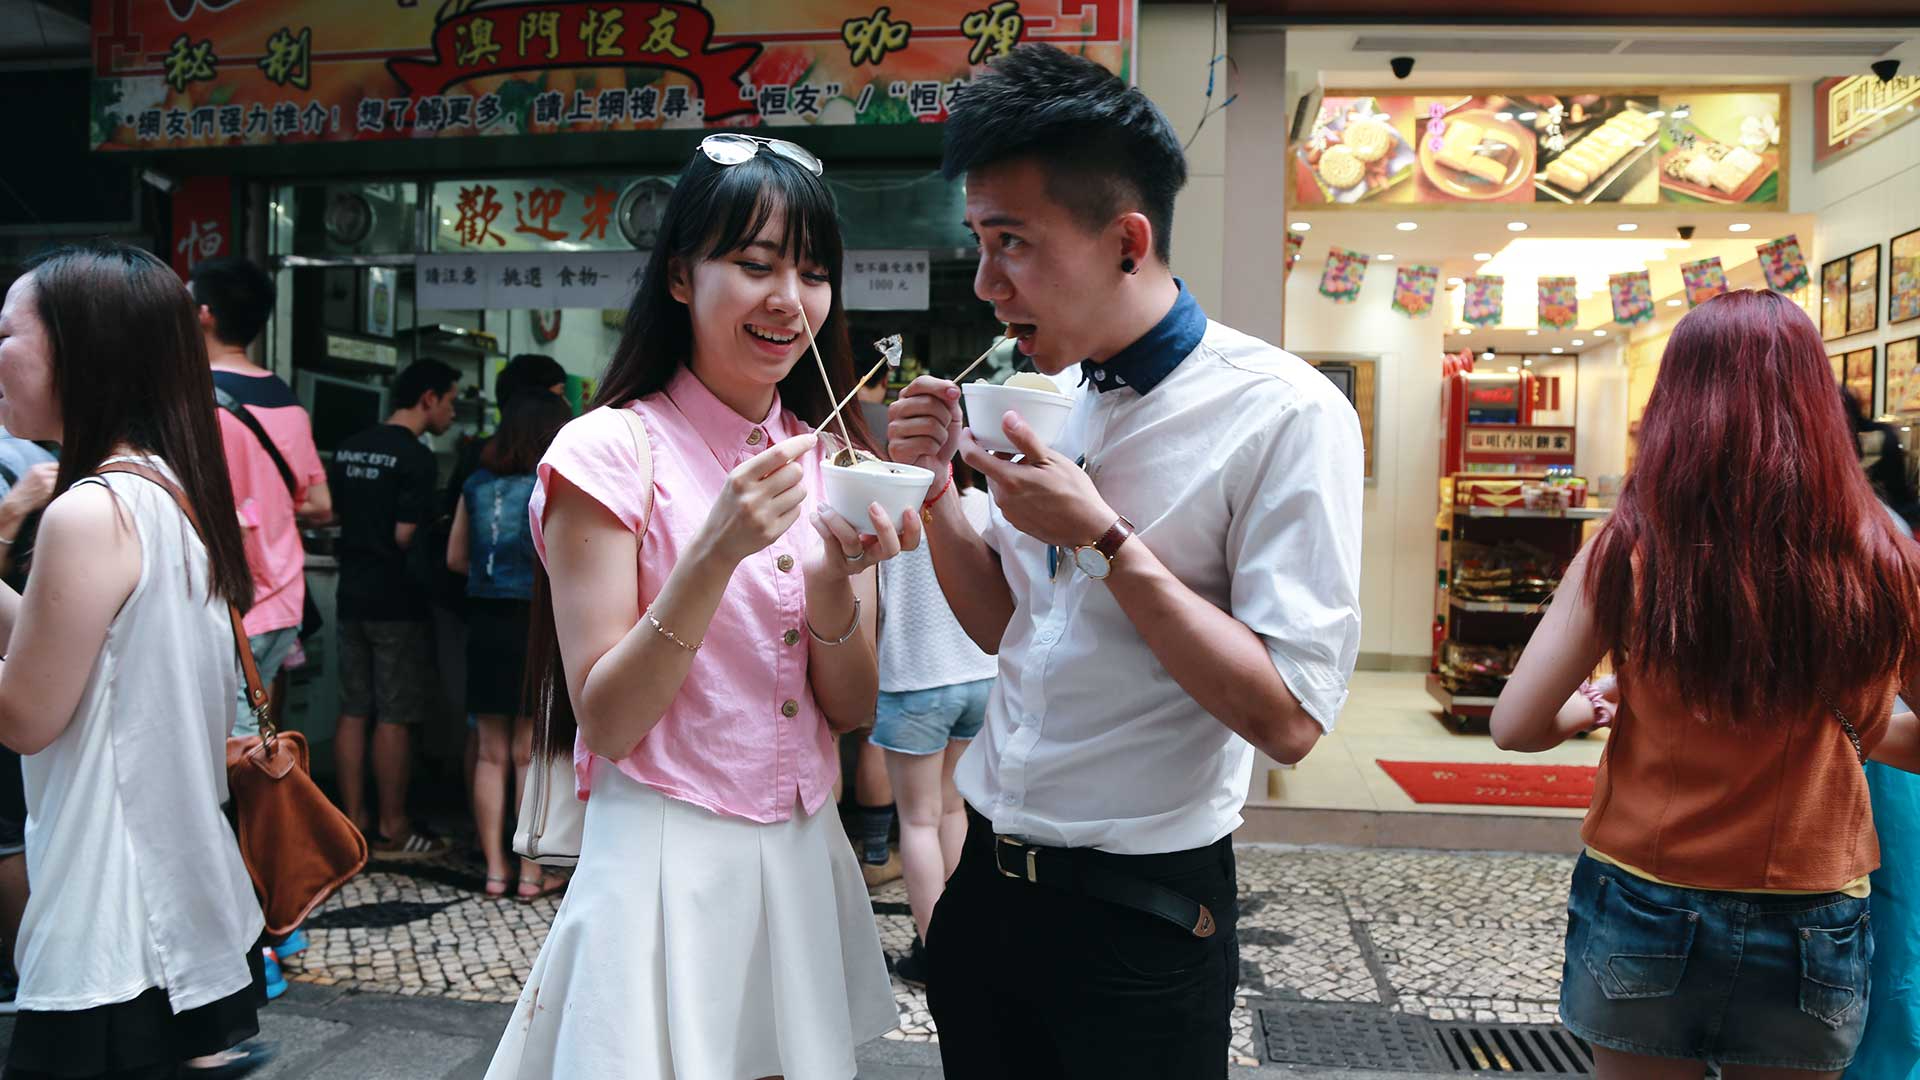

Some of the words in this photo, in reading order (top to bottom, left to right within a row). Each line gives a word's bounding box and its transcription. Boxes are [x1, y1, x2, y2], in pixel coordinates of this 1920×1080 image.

[456, 8, 690, 66] 澳門恒友
[501, 266, 544, 289] 挑選
